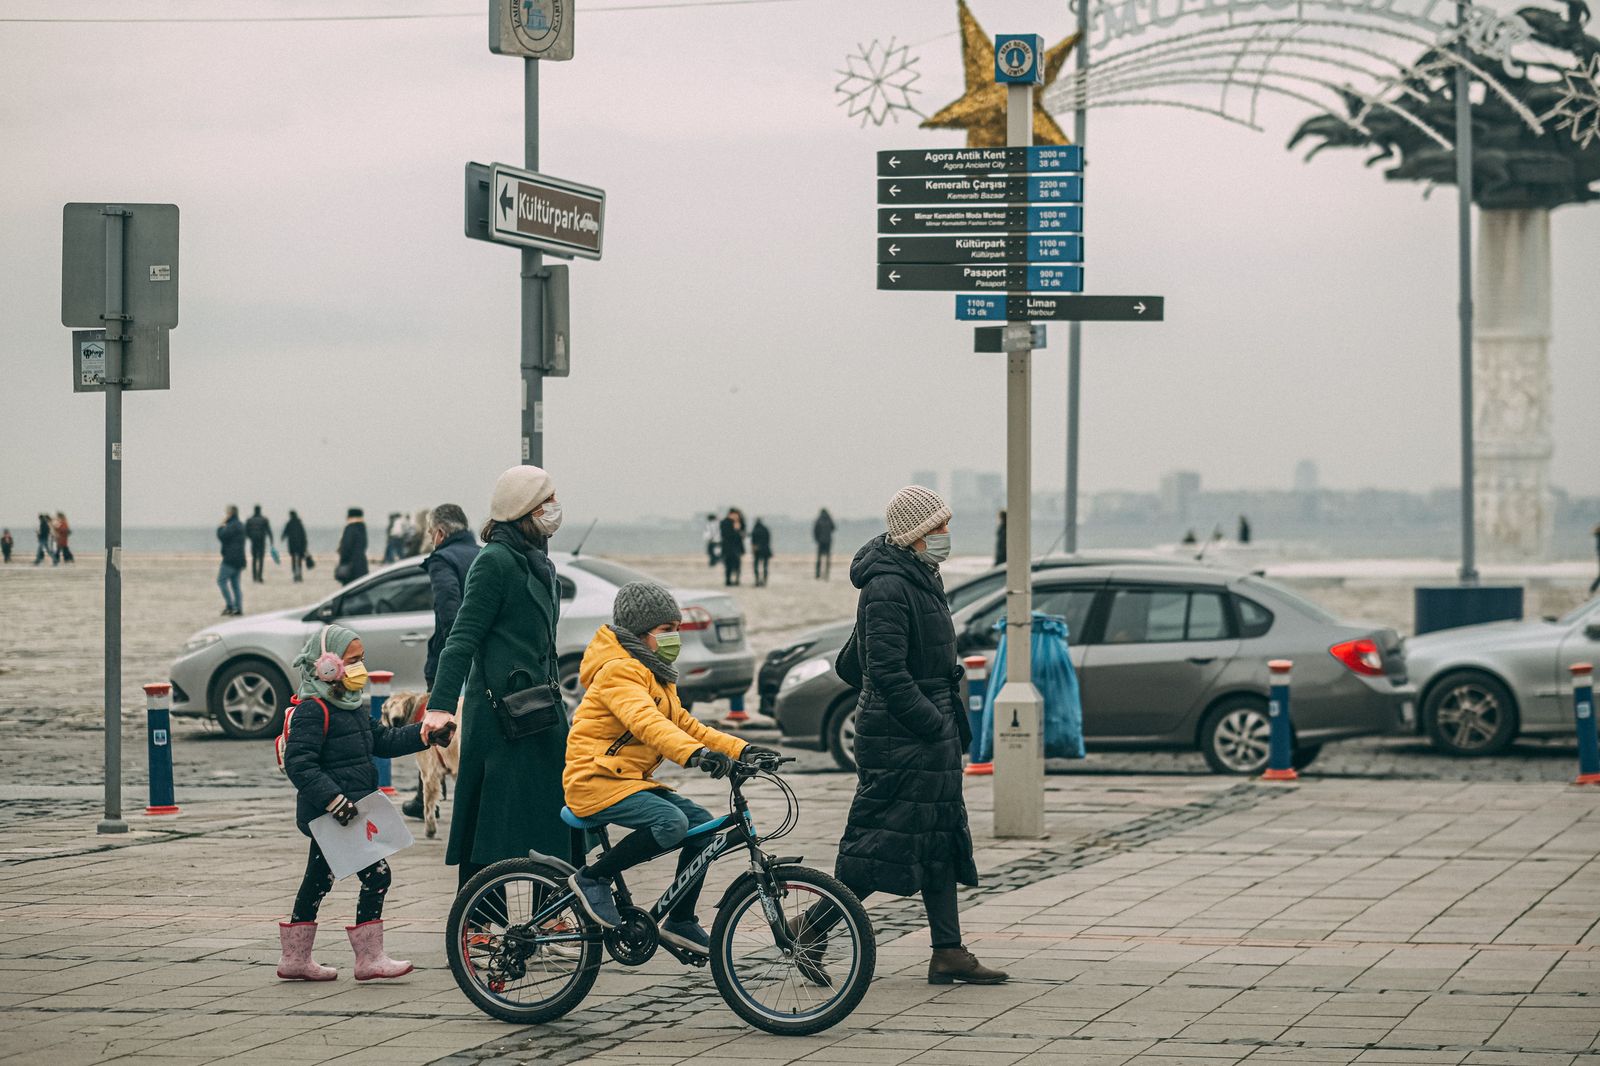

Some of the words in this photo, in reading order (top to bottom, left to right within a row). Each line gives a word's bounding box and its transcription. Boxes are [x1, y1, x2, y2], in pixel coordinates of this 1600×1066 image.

[925, 152, 954, 163] Agora
[956, 151, 981, 160] Antik
[983, 150, 1006, 160] Kent
[965, 161, 991, 169] Ancient
[992, 161, 1006, 169] City
[1050, 159, 1060, 167] dk
[925, 180, 971, 190] Kemeraltı
[973, 179, 1006, 191] Çarşısı
[1040, 190, 1050, 198] 26
[1050, 189, 1061, 198] dk
[519, 192, 580, 234] Kültürpark
[1039, 220, 1049, 228] 20
[1050, 219, 1061, 228] dk
[955, 239, 1006, 250] Kültürpark
[970, 251, 1006, 259] Kültürpark
[1049, 248, 1060, 256] dk
[963, 268, 1007, 279] Pasaport
[1039, 270, 1054, 278] 900
[975, 280, 1006, 288] Pasaport
[1040, 279, 1049, 287] 12
[1050, 279, 1061, 287] dk
[967, 299, 985, 307] 1100
[986, 300, 995, 308] m
[1026, 298, 1056, 308] Liman
[967, 308, 976, 316] 13
[977, 308, 987, 317] dk
[1026, 308, 1055, 316] Harbour
